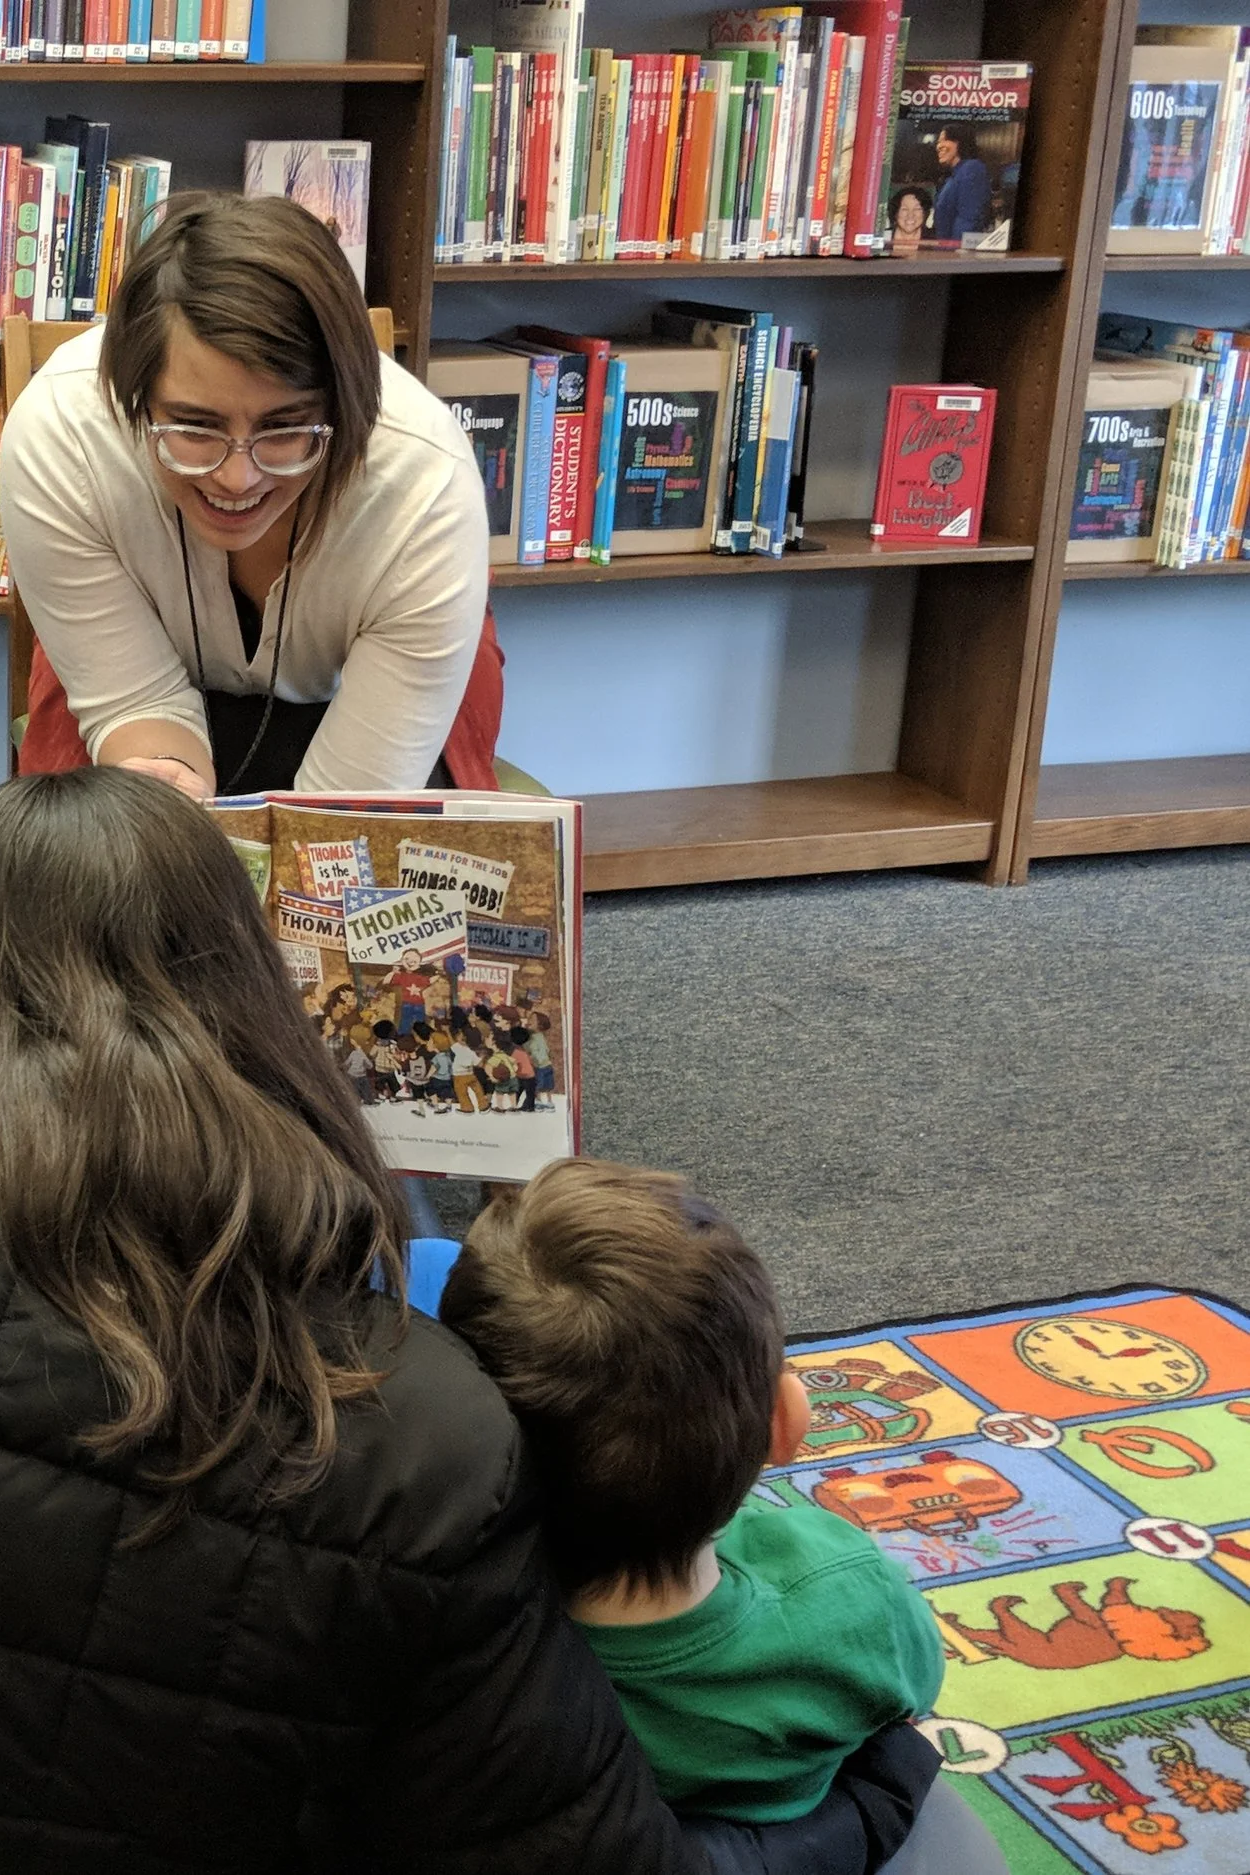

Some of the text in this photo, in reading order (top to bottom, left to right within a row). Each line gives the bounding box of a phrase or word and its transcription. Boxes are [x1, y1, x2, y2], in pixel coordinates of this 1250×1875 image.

[829, 70, 838, 96] FAIRS
[876, 33, 895, 119] DRAGONOLOGY
[928, 74, 992, 91] SONIA
[900, 90, 1018, 108] SOTOMAYOR
[1130, 91, 1174, 119] 600s
[821, 109, 833, 157] FESTIVALS
[817, 174, 827, 200] INDIA
[24, 206, 35, 229] deep
[51, 224, 66, 299] FALLOU
[738, 344, 748, 383] EARTH
[748, 330, 767, 442] SCIENCE ENCYCLOPEDIA
[451, 402, 504, 432] 0s Language
[626, 398, 699, 426] 500s Science
[1088, 416, 1130, 443] 700s
[1130, 428, 1143, 438] Arts
[1133, 437, 1165, 447] Recreation
[549, 419, 567, 527] DICTIONARY
[565, 426, 582, 518] STUDENT'S
[625, 468, 667, 480] Astronomy
[644, 455, 694, 467] Mathematics
[310, 845, 354, 862] THOMAS
[404, 846, 508, 879] THE MAN FOR THE JOB
[319, 863, 350, 878] is the
[461, 880, 505, 914] COBB!
[281, 912, 346, 938] THOMA
[347, 892, 444, 941] THOMAS
[351, 911, 464, 961] for PRESIDENT
[468, 925, 548, 951] THOMAS IS #1
[300, 967, 318, 979] COBB
[459, 966, 507, 984] HOMAS
[980, 1416, 1053, 1446] 16
[1131, 1522, 1207, 1554] 11
